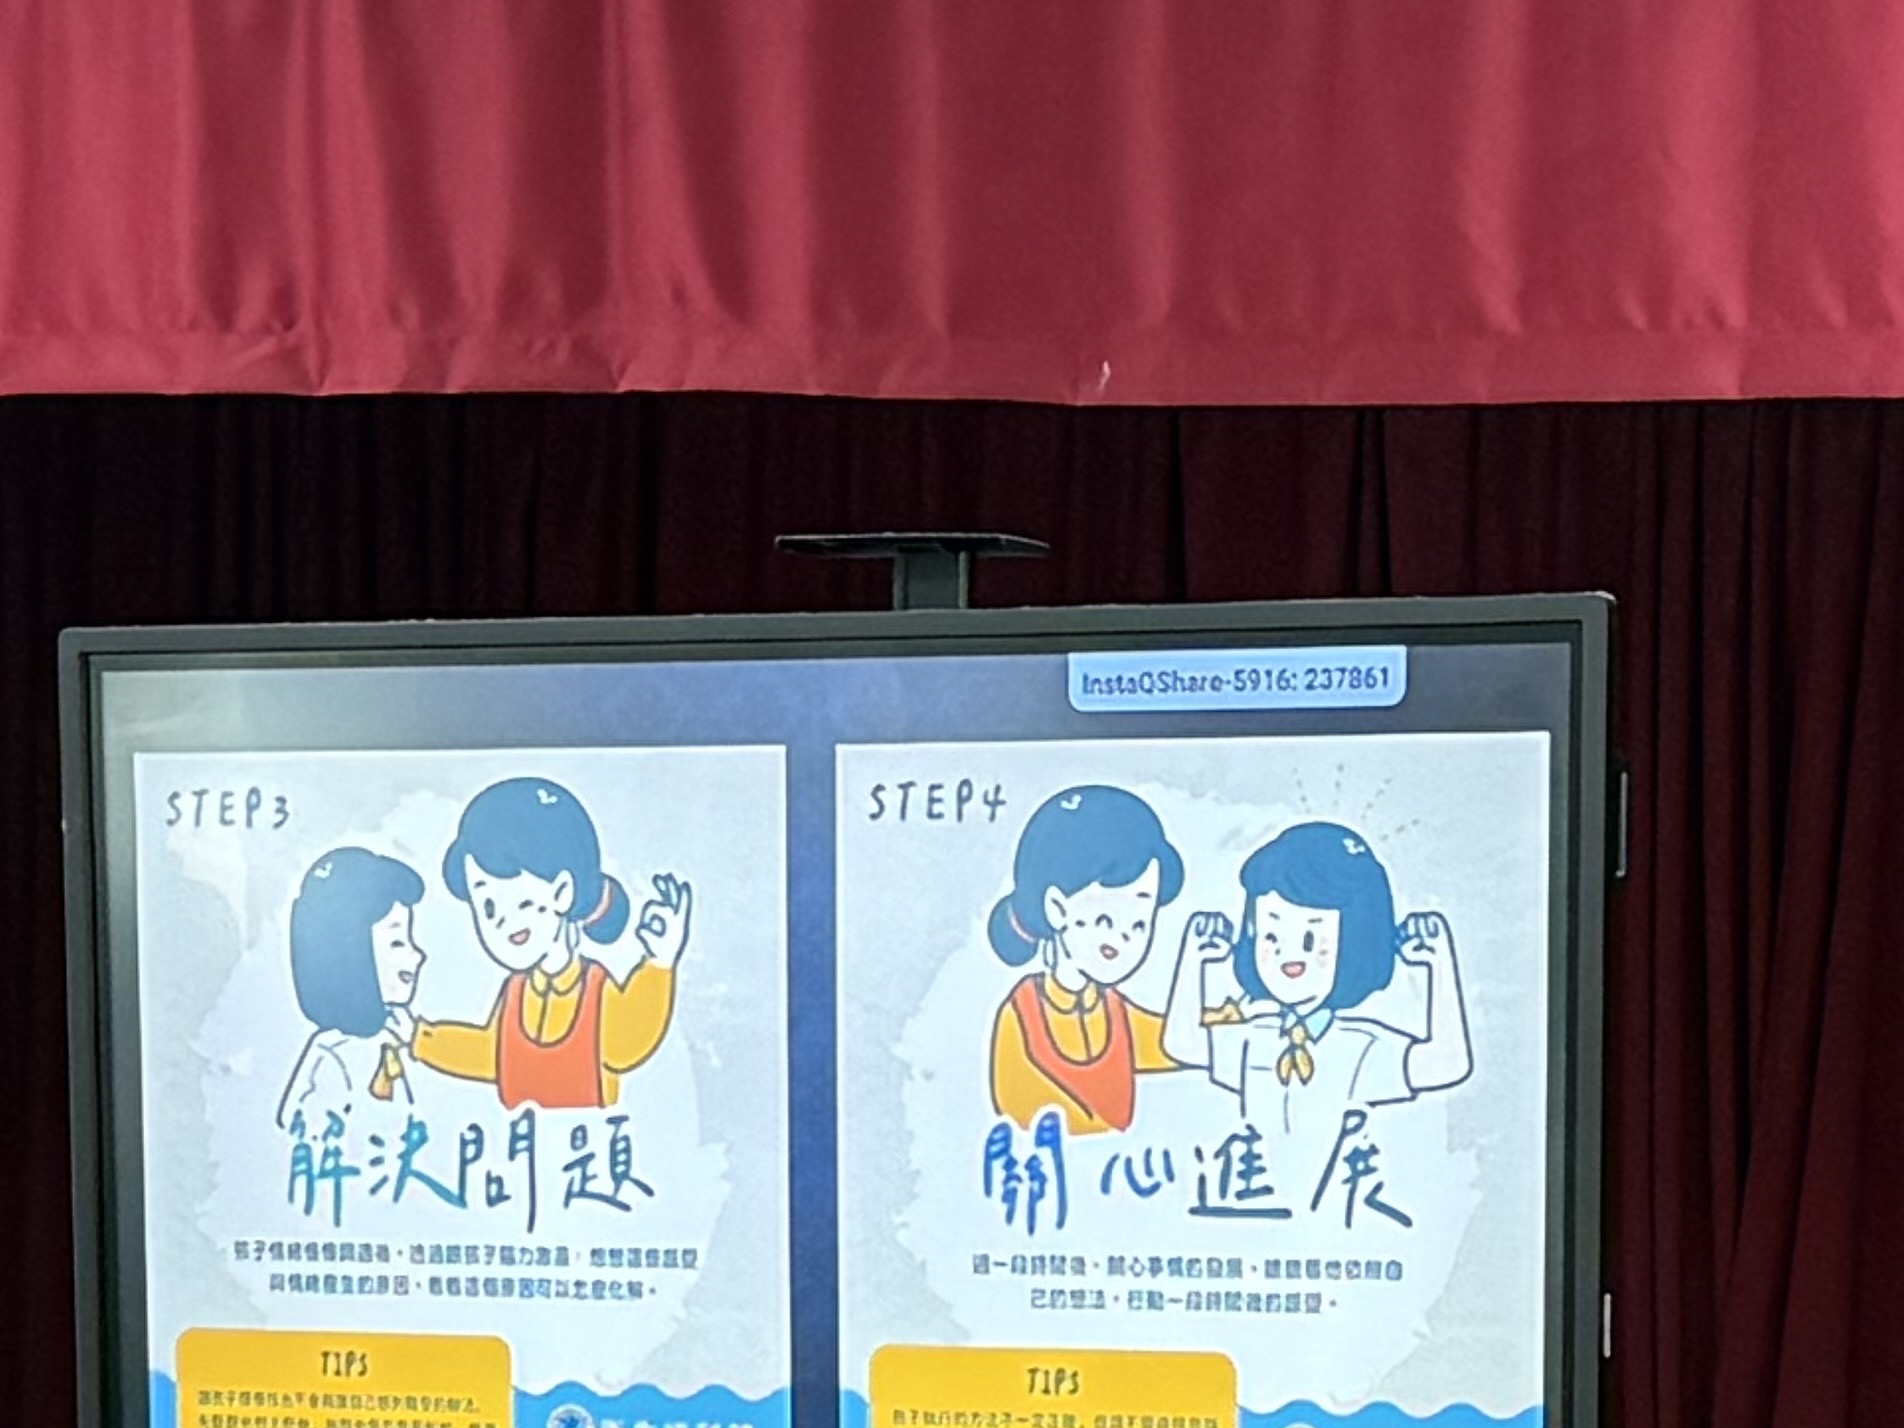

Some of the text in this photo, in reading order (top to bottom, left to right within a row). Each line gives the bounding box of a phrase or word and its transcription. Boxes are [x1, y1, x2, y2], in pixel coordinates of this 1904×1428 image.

[1304, 667, 1390, 691] 237861
[288, 1107, 654, 1233] 解決問題
[983, 1109, 1413, 1235] 關心進展
[320, 1350, 369, 1377] TIPS
[1027, 1367, 1080, 1396] TIPS
